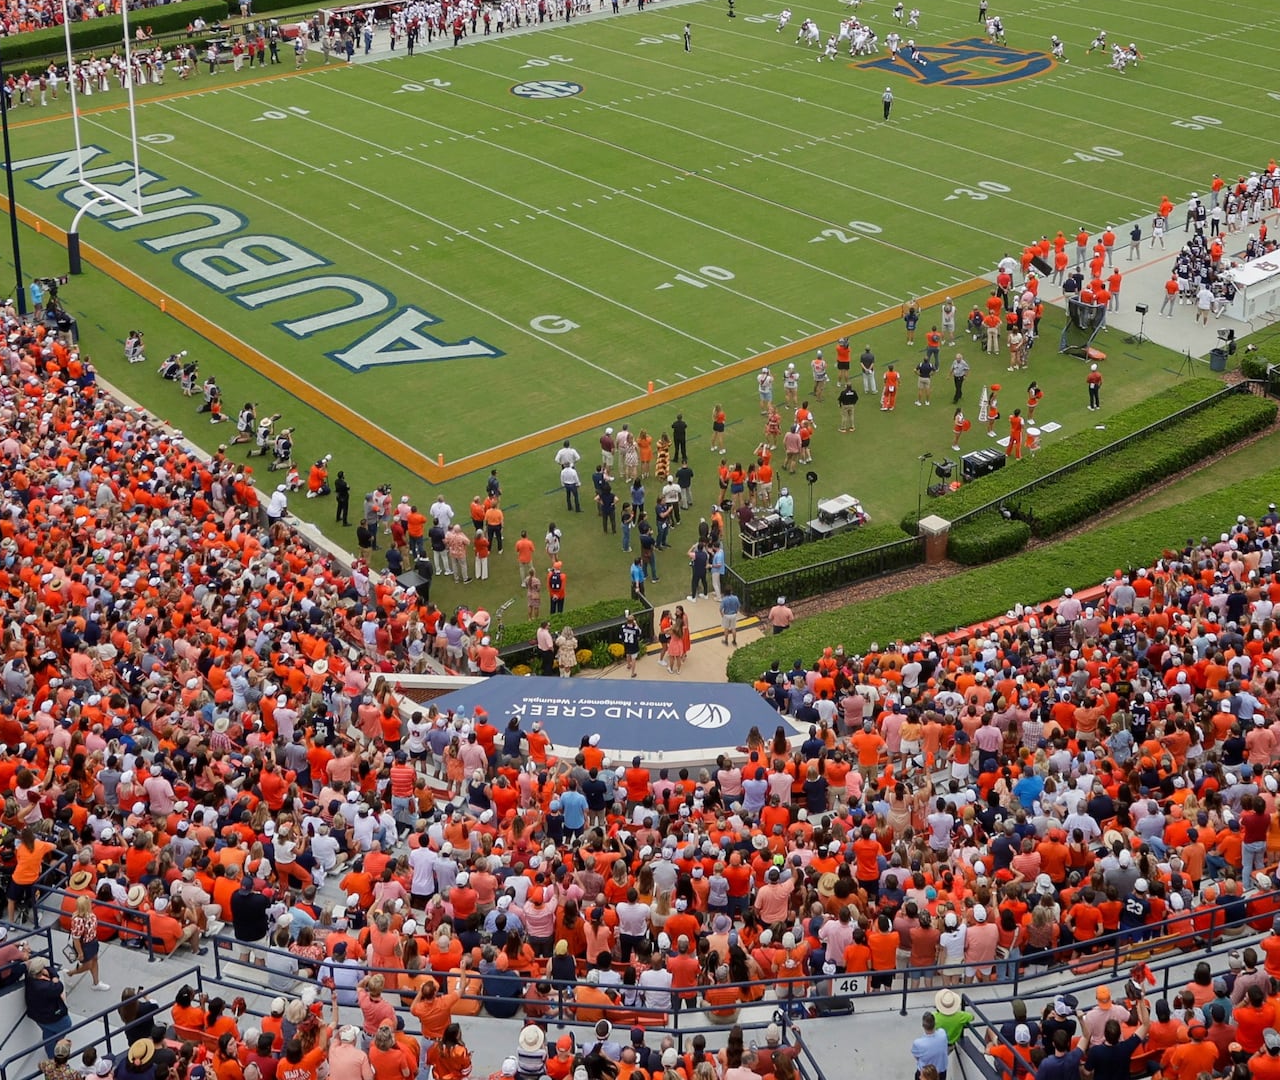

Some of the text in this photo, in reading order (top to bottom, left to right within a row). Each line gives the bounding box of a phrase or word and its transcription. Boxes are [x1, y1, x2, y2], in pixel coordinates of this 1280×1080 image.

[536, 54, 574, 68] 30
[406, 78, 452, 92] 20
[264, 106, 310, 121] 10
[1171, 115, 1224, 131] 50
[1076, 146, 1124, 164] 40
[953, 180, 1012, 202] 30
[822, 220, 883, 244] 20
[673, 265, 736, 289] 10
[529, 314, 581, 335] G
[624, 632, 634, 643] 14
[578, 698, 632, 707] Montgomery
[512, 704, 680, 720] WIND CREEK
[1132, 716, 1145, 726] 34
[1126, 903, 1144, 915] 23
[840, 979, 858, 992] 46
